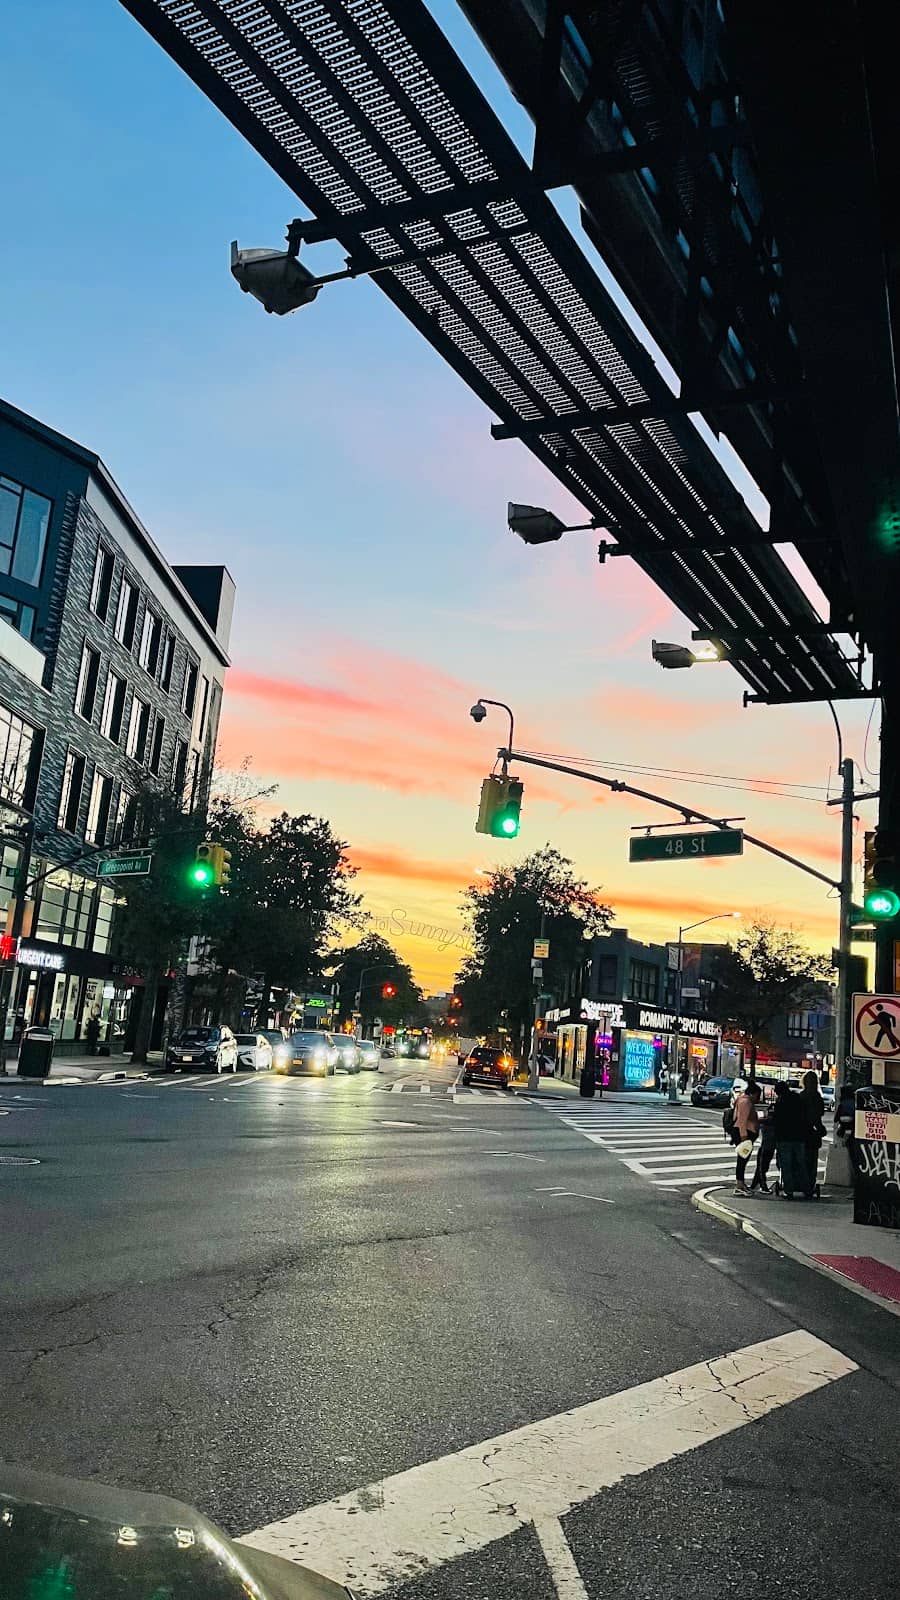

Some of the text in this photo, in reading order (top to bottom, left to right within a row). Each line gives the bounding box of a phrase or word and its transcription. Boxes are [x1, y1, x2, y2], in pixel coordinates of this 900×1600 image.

[665, 836, 705, 855] 48 St
[105, 861, 133, 873] Greenpoint
[389, 908, 491, 958] Sunnysie
[17, 948, 64, 970] URGENT CARE
[581, 997, 624, 1016] ROMANTIC
[677, 1016, 699, 1034] DEPOT
[626, 1041, 655, 1056] WELCOME
[626, 1054, 653, 1068] SINGLES
